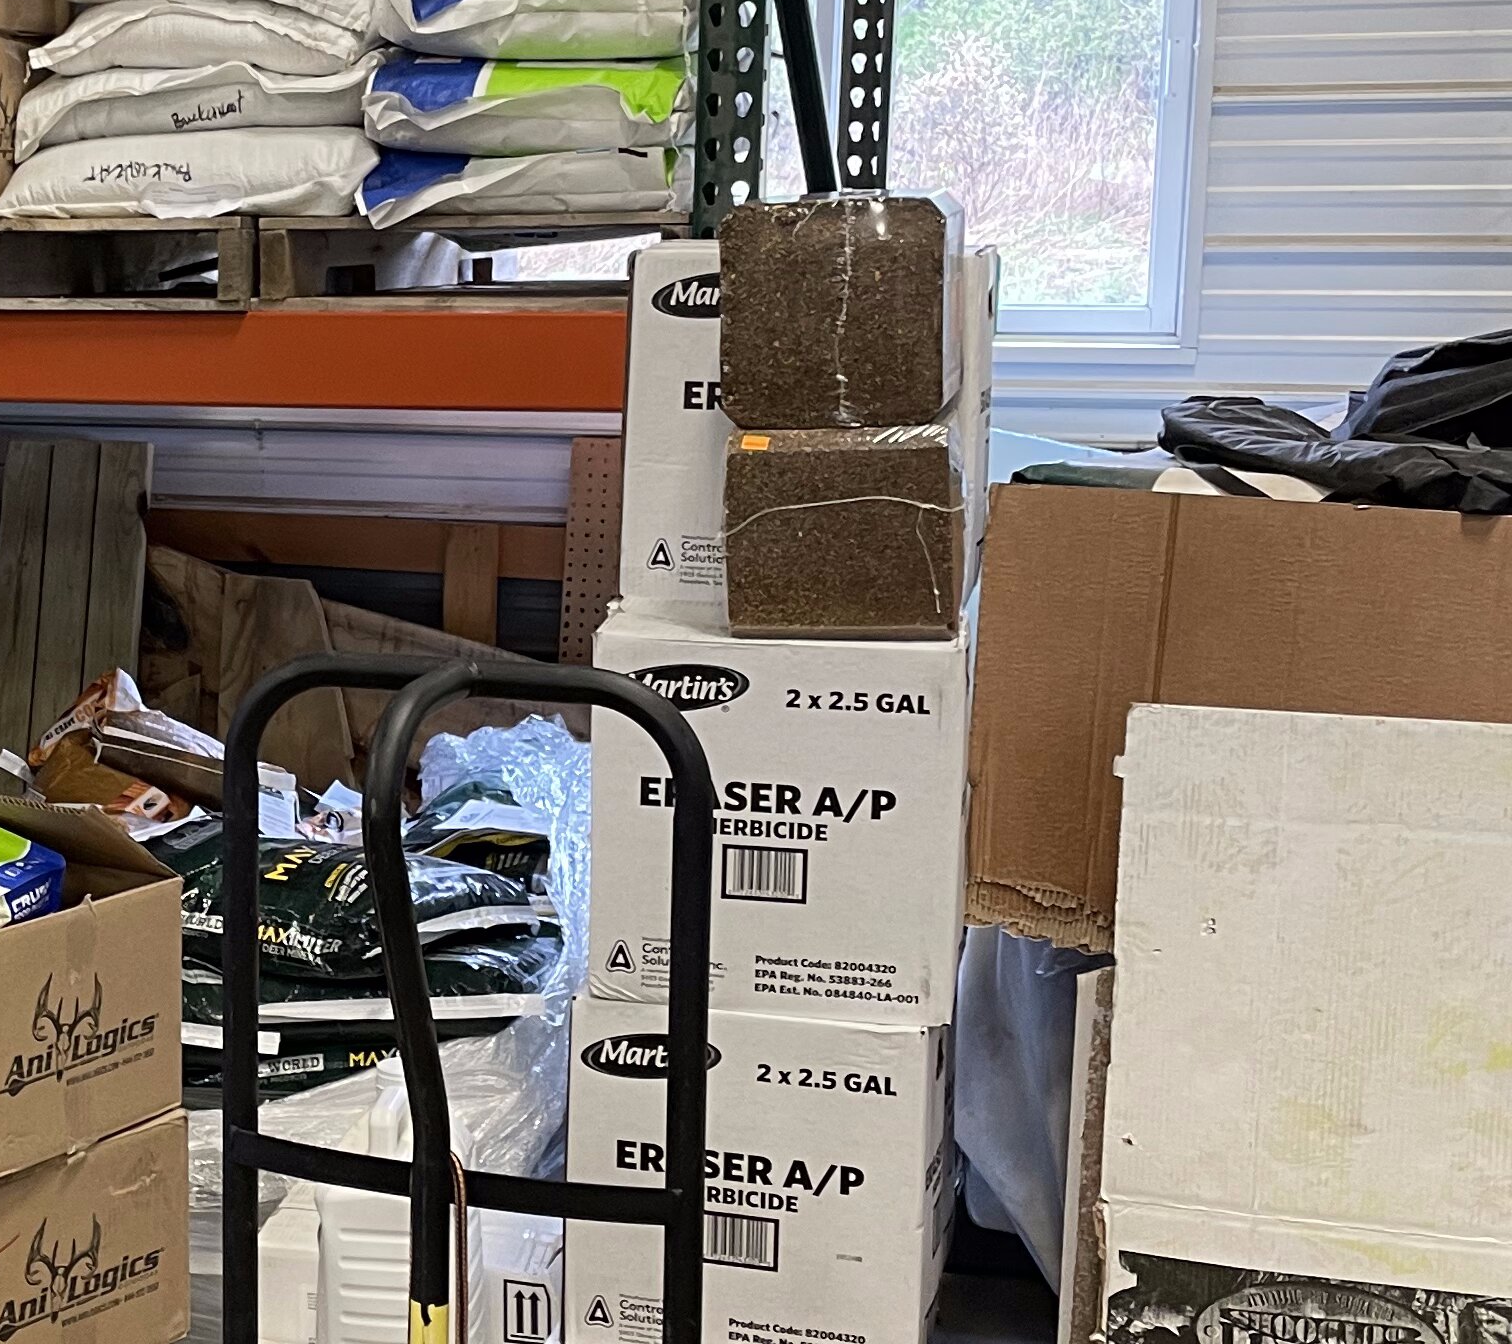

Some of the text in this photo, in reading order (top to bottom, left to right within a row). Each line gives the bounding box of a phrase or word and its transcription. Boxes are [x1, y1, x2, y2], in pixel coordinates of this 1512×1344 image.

[786, 689, 931, 715] 2 x 2.5 GAL
[640, 776, 897, 823] ESER A/P
[754, 955, 799, 968] Product
[801, 957, 832, 970] Code:
[754, 969, 777, 980] EPA
[754, 983, 777, 994] EPA
[71, 1015, 157, 1062] Logics
[600, 1039, 669, 1068] Mart
[756, 1064, 897, 1097] 2 x 2.5 GAL
[616, 1139, 865, 1197] ERSER A/P
[707, 1186, 799, 1213] RBICIDE
[67, 1249, 161, 1304] Logics
[619, 1300, 664, 1315] Contro
[619, 1310, 664, 1326] Solutio
[728, 1318, 770, 1333] Product
[772, 1324, 803, 1338] Code:
[728, 1332, 751, 1344] EPA
